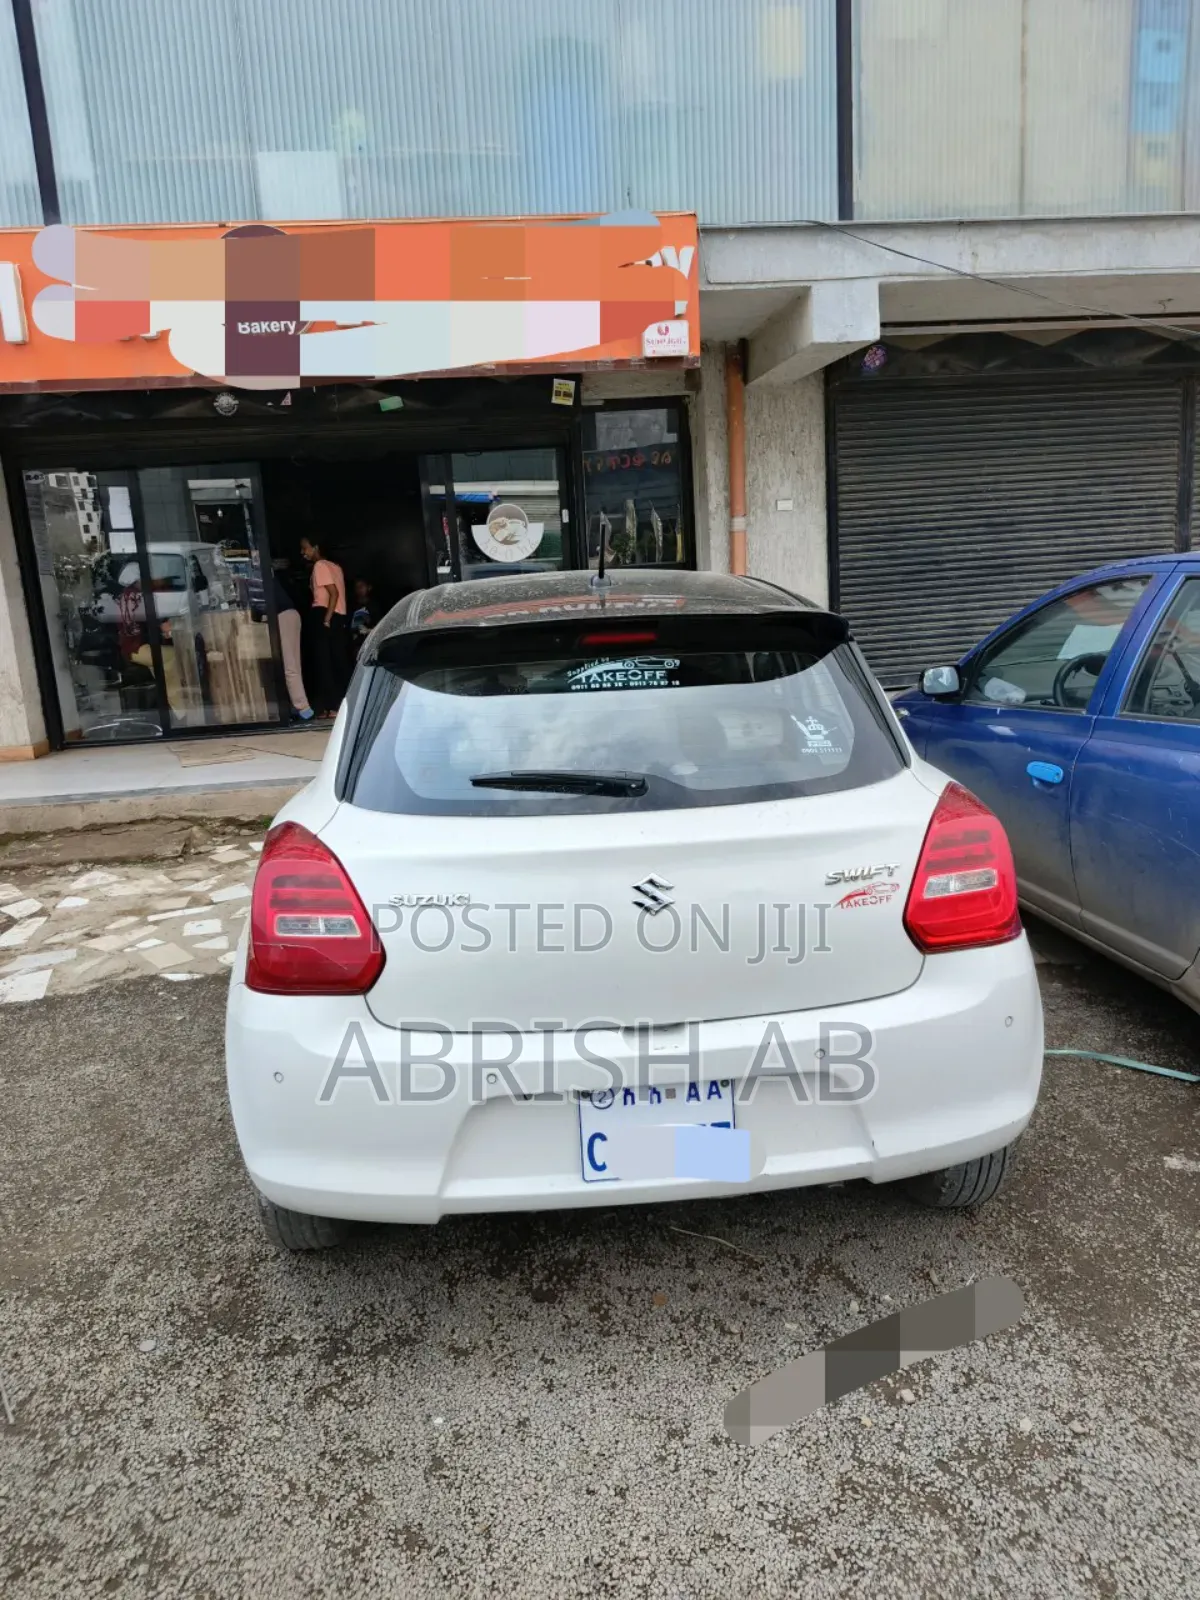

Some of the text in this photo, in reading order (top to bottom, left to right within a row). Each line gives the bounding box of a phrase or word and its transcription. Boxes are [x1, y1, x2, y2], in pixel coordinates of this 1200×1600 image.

[237, 320, 296, 335] Bakery
[579, 670, 667, 684] TAKEOFF
[825, 863, 900, 885] SWIFT
[389, 893, 471, 907] SUZUKI
[839, 894, 893, 910] TAKEOFF
